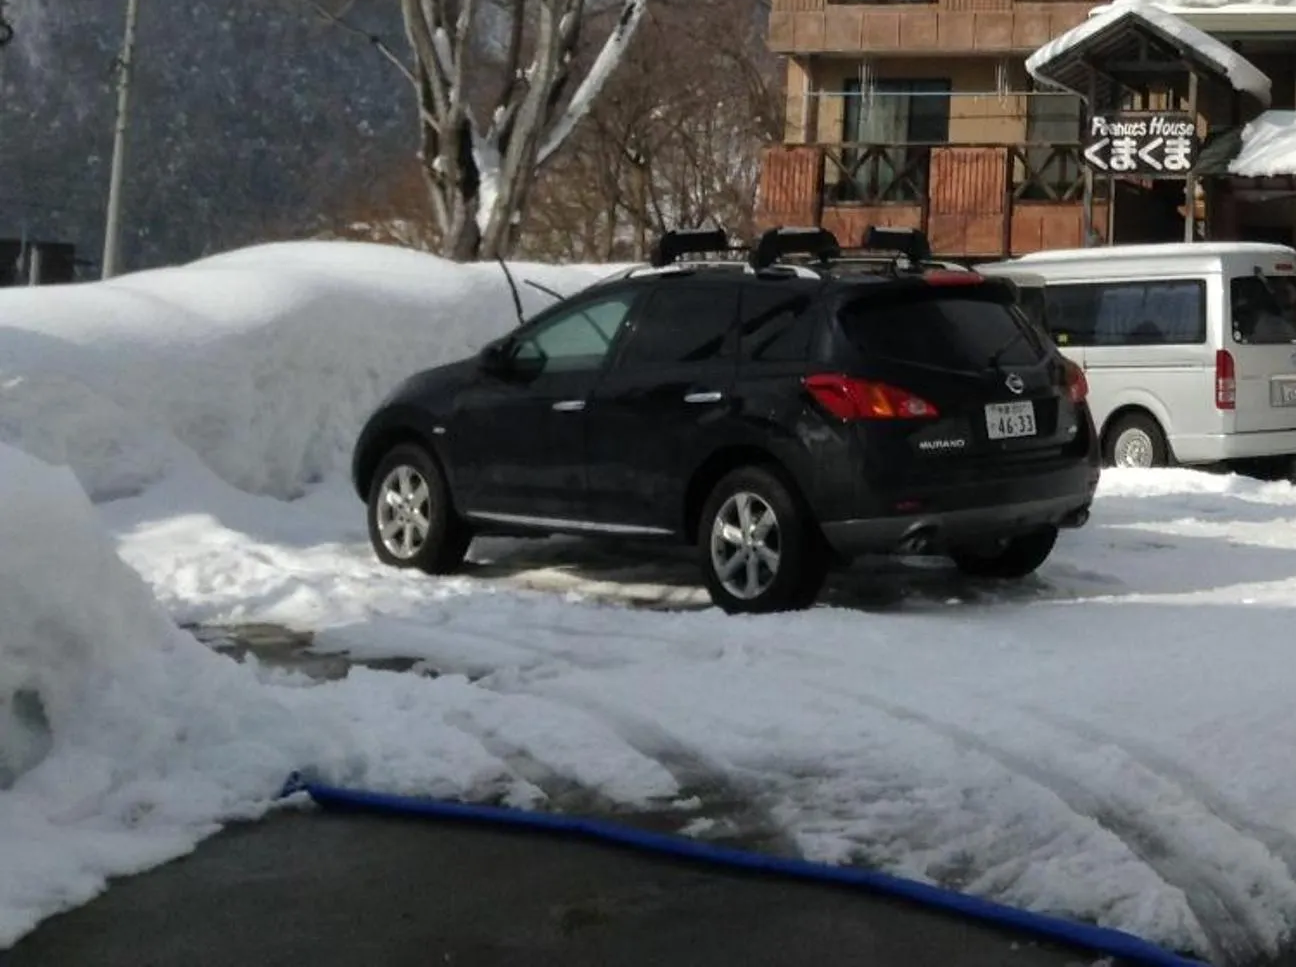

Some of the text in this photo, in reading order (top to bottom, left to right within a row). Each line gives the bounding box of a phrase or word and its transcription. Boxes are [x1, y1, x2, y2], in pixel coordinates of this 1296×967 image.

[1091, 115, 1195, 136] Peanuts House
[1084, 136, 1192, 171] くまくま
